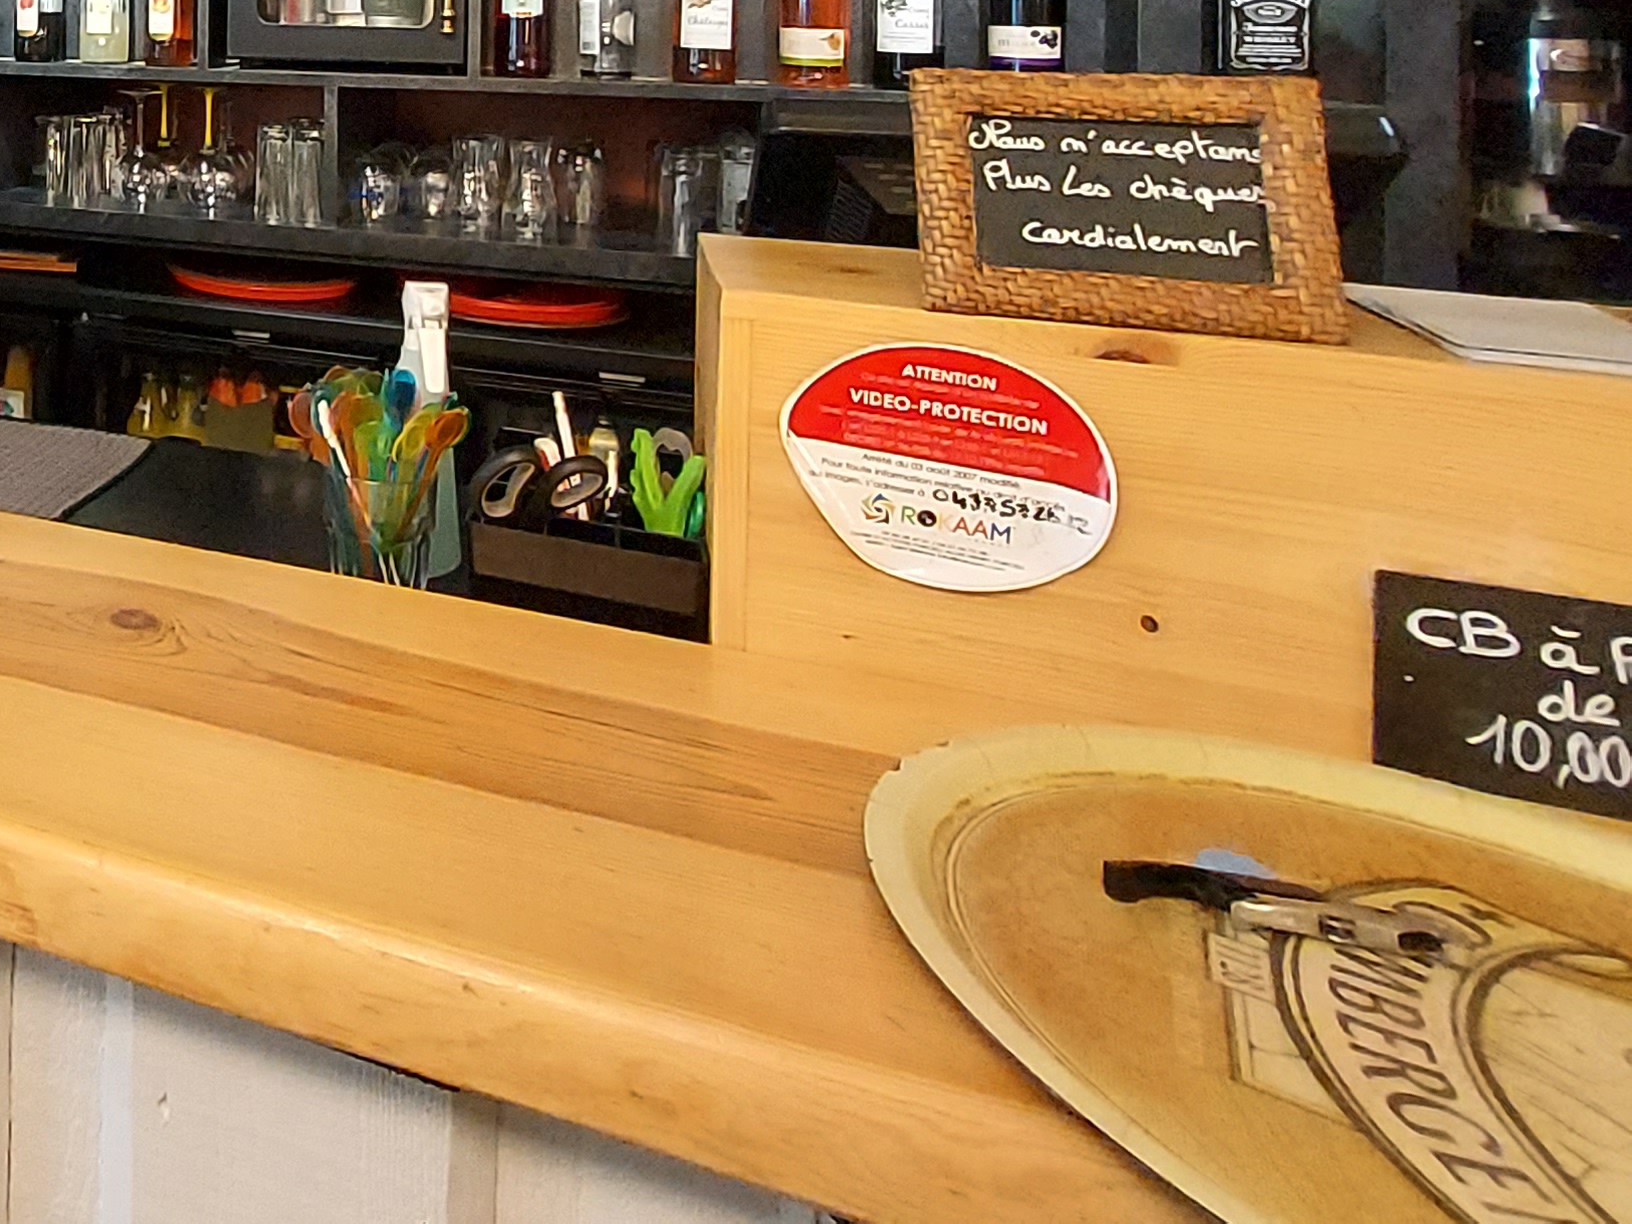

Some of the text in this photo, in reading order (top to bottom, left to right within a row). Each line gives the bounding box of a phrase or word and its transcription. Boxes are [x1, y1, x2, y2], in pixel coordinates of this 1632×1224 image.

[981, 158, 1052, 193] Plus
[901, 363, 998, 392] ATTENTION
[848, 386, 1049, 437] VIDEO-PROTECTION
[1405, 607, 1522, 659] CB
[1539, 624, 1602, 676] à
[1537, 679, 1622, 728] de
[1464, 713, 1632, 791] 10,00
